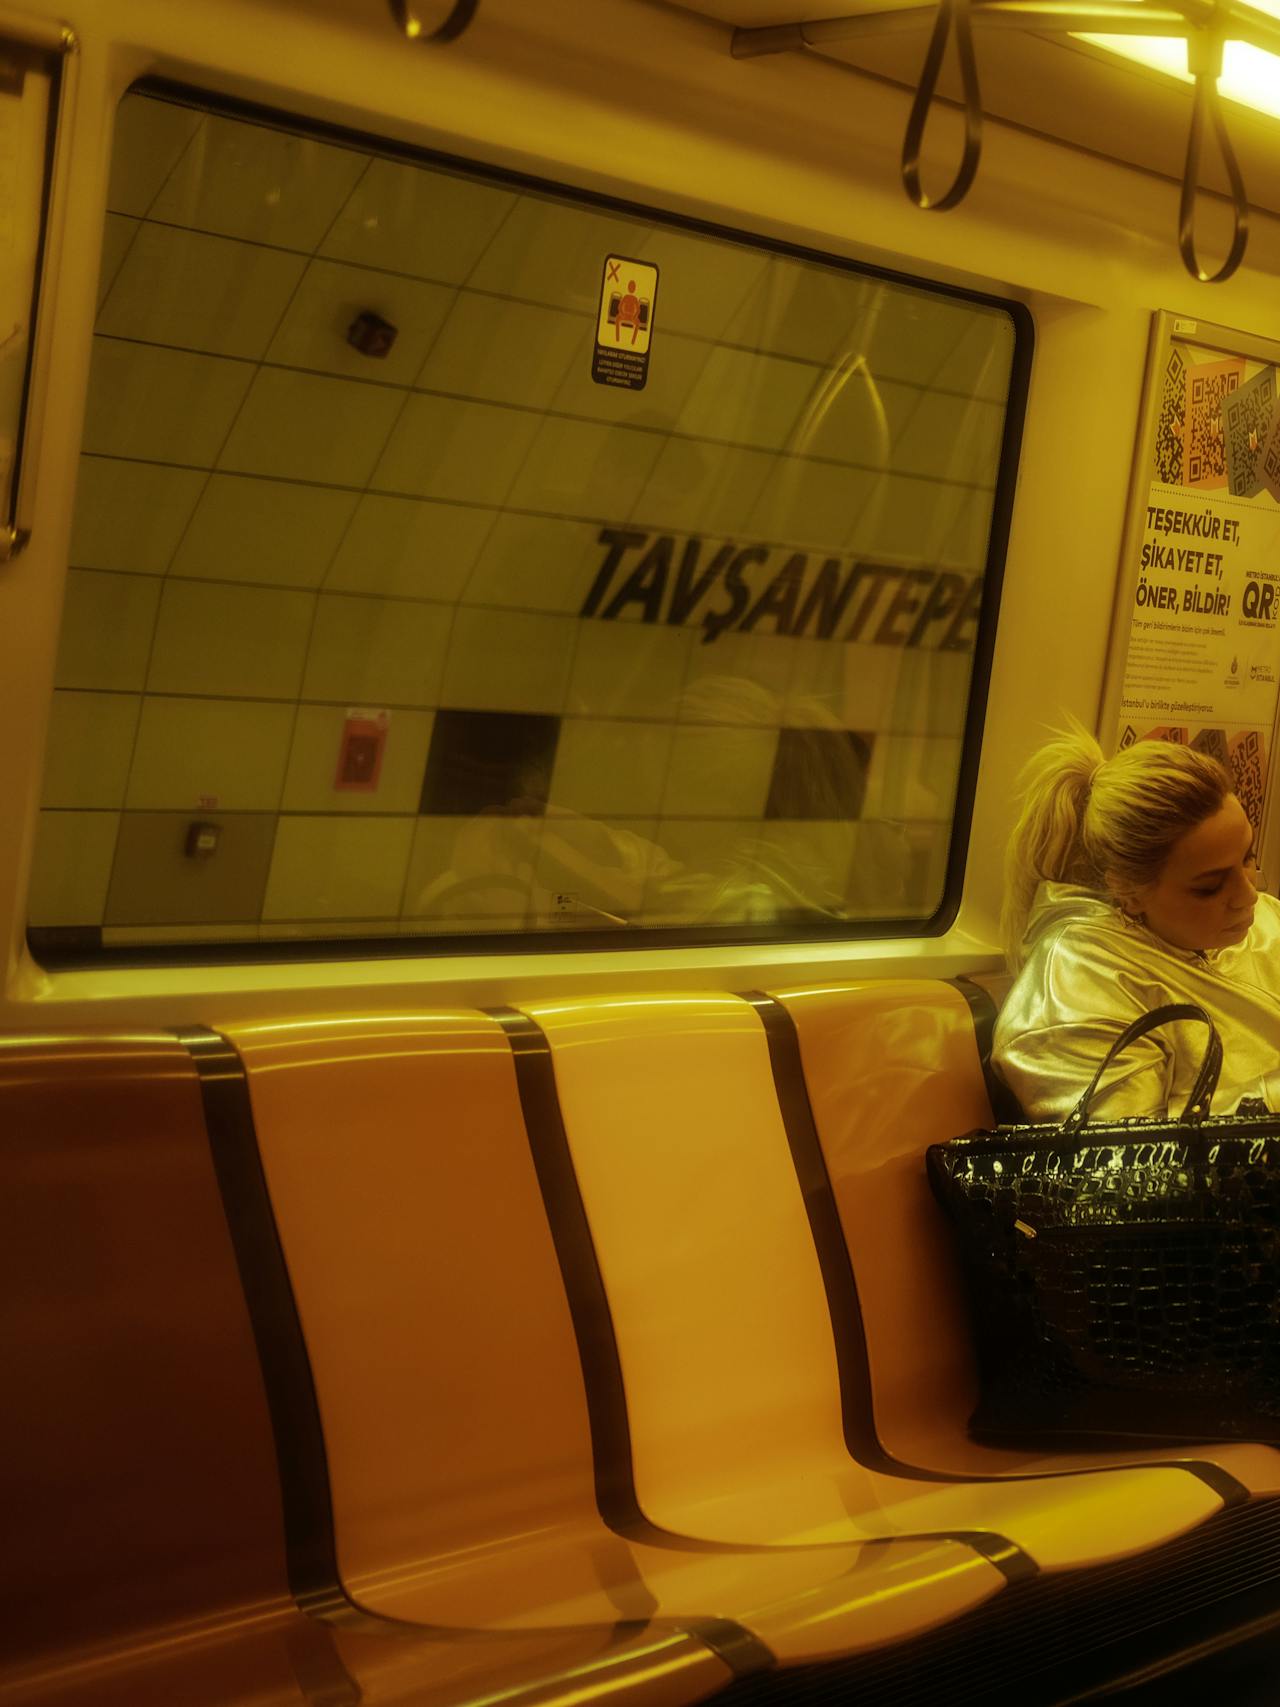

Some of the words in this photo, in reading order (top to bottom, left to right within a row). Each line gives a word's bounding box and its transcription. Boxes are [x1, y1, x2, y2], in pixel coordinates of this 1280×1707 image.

[1147, 507, 1221, 540] TEŞEKKÜR
[1223, 520, 1240, 546] ET,
[1141, 539, 1204, 572] ŞİKAYET
[1205, 553, 1224, 580] ET,
[580, 529, 984, 652] TAVŞANTEPE
[1136, 578, 1180, 614] ÖNER,
[1183, 584, 1231, 616] BİLDİR!
[1243, 581, 1274, 620] QR
[1272, 586, 1280, 620] KOD
